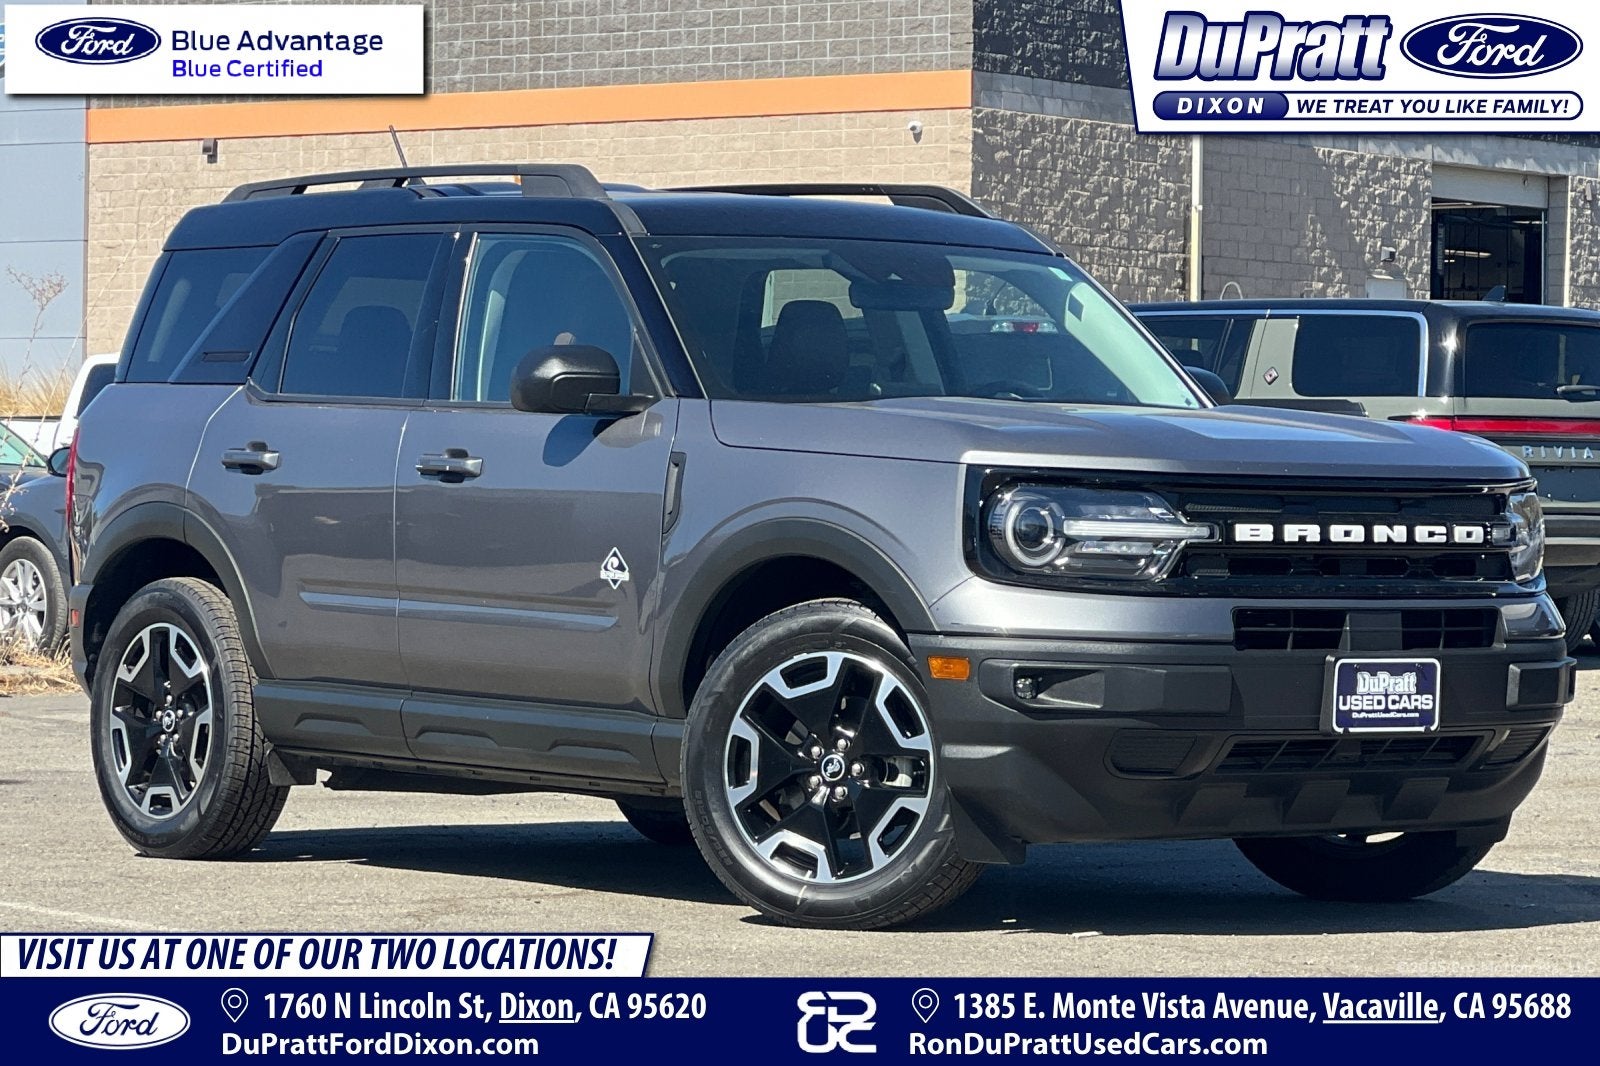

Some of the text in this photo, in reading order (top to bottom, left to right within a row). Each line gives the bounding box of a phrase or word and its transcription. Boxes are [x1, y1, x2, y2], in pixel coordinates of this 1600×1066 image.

[1234, 522, 1485, 545] BRONCO
[1357, 671, 1416, 694] DuPratt
[1338, 694, 1434, 710] USED CARS
